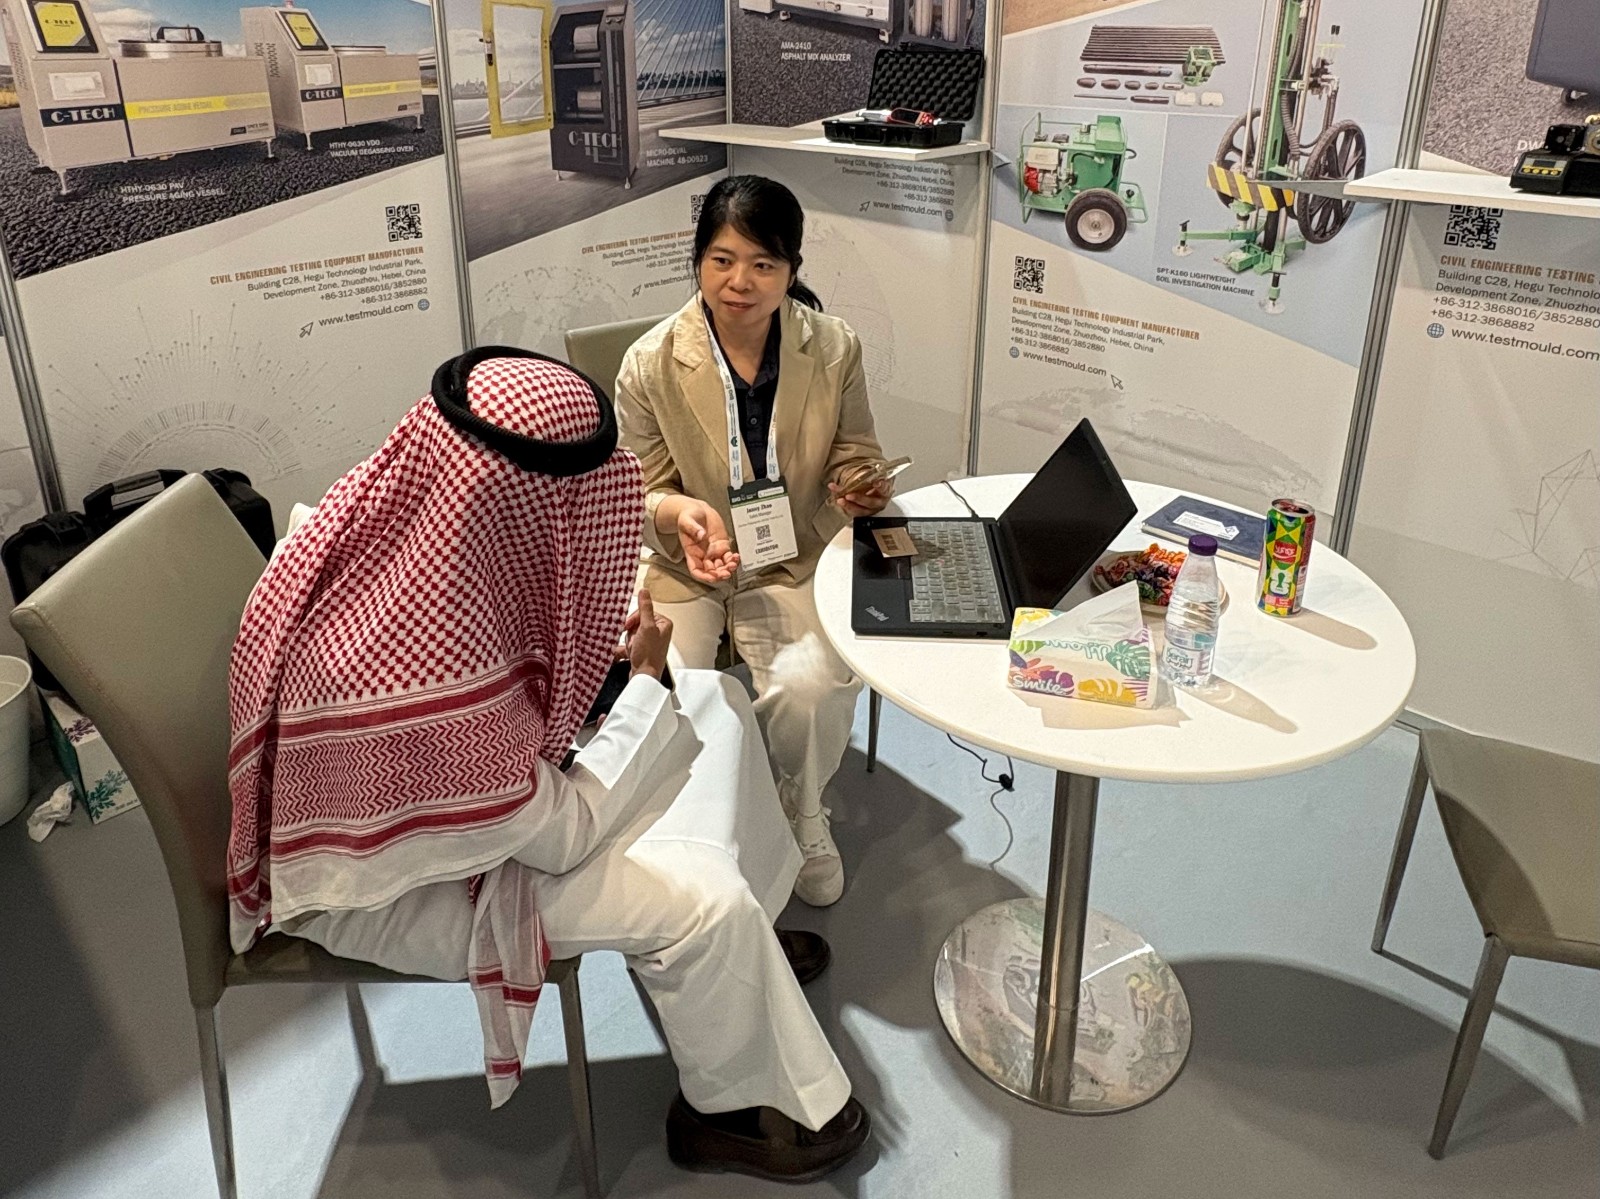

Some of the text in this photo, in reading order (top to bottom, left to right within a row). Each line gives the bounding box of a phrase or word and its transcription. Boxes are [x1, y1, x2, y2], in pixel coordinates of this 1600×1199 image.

[781, 41, 812, 50] AMA-2410
[781, 52, 851, 62] ASPHALT MIX ANALYZER
[305, 89, 339, 99] C-TECH
[51, 108, 115, 124] C-TECH
[568, 130, 621, 148] C-TECH
[1517, 140, 1546, 151] DW
[330, 149, 358, 158] VACUUM
[359, 146, 396, 156] DEGASSING
[646, 158, 676, 167] MACHINE
[122, 188, 225, 203] PRESSURE AGING VESSEL
[169, 182, 184, 190] PAV
[210, 246, 424, 286] CIVIL ENGINEERING TESTING EQUIPMENT MANUFACTURER
[248, 279, 282, 292] Building
[304, 272, 325, 284] Hegu
[326, 265, 368, 280] Technology
[369, 260, 403, 272] Industrial
[404, 257, 424, 267] Park,
[1440, 254, 1596, 284] CIVIL ENGINEERING TESTING
[264, 286, 316, 301] Development
[406, 268, 426, 277] China
[1156, 275, 1255, 296] SOIL INVESTIGATION MACHINE
[1190, 272, 1236, 284] LIGHTWEIGHT
[1438, 269, 1600, 300] Building C28, Hegu Technolo
[1436, 282, 1508, 302] Development
[1509, 292, 1542, 306] Zone,
[318, 302, 414, 328] www.testmould.com
[1012, 296, 1200, 341] CIVIL ENGINEERING TESTING EQUIPMENT MANUFACTURER
[1431, 309, 1536, 332] +86-312-3868882
[1432, 296, 1600, 329] +86-312-3868016/3852880
[1011, 316, 1052, 332] Development
[1133, 342, 1154, 354] China
[1012, 306, 1038, 320] Building
[1054, 316, 1072, 326] Hegu
[1074, 319, 1110, 334] Technology
[1112, 326, 1144, 341] Industrial
[1146, 334, 1166, 346] Park,
[1450, 328, 1600, 362] www.testmould.com
[1022, 350, 1107, 377] www.testmould.com
[1012, 674, 1067, 697] Smile
